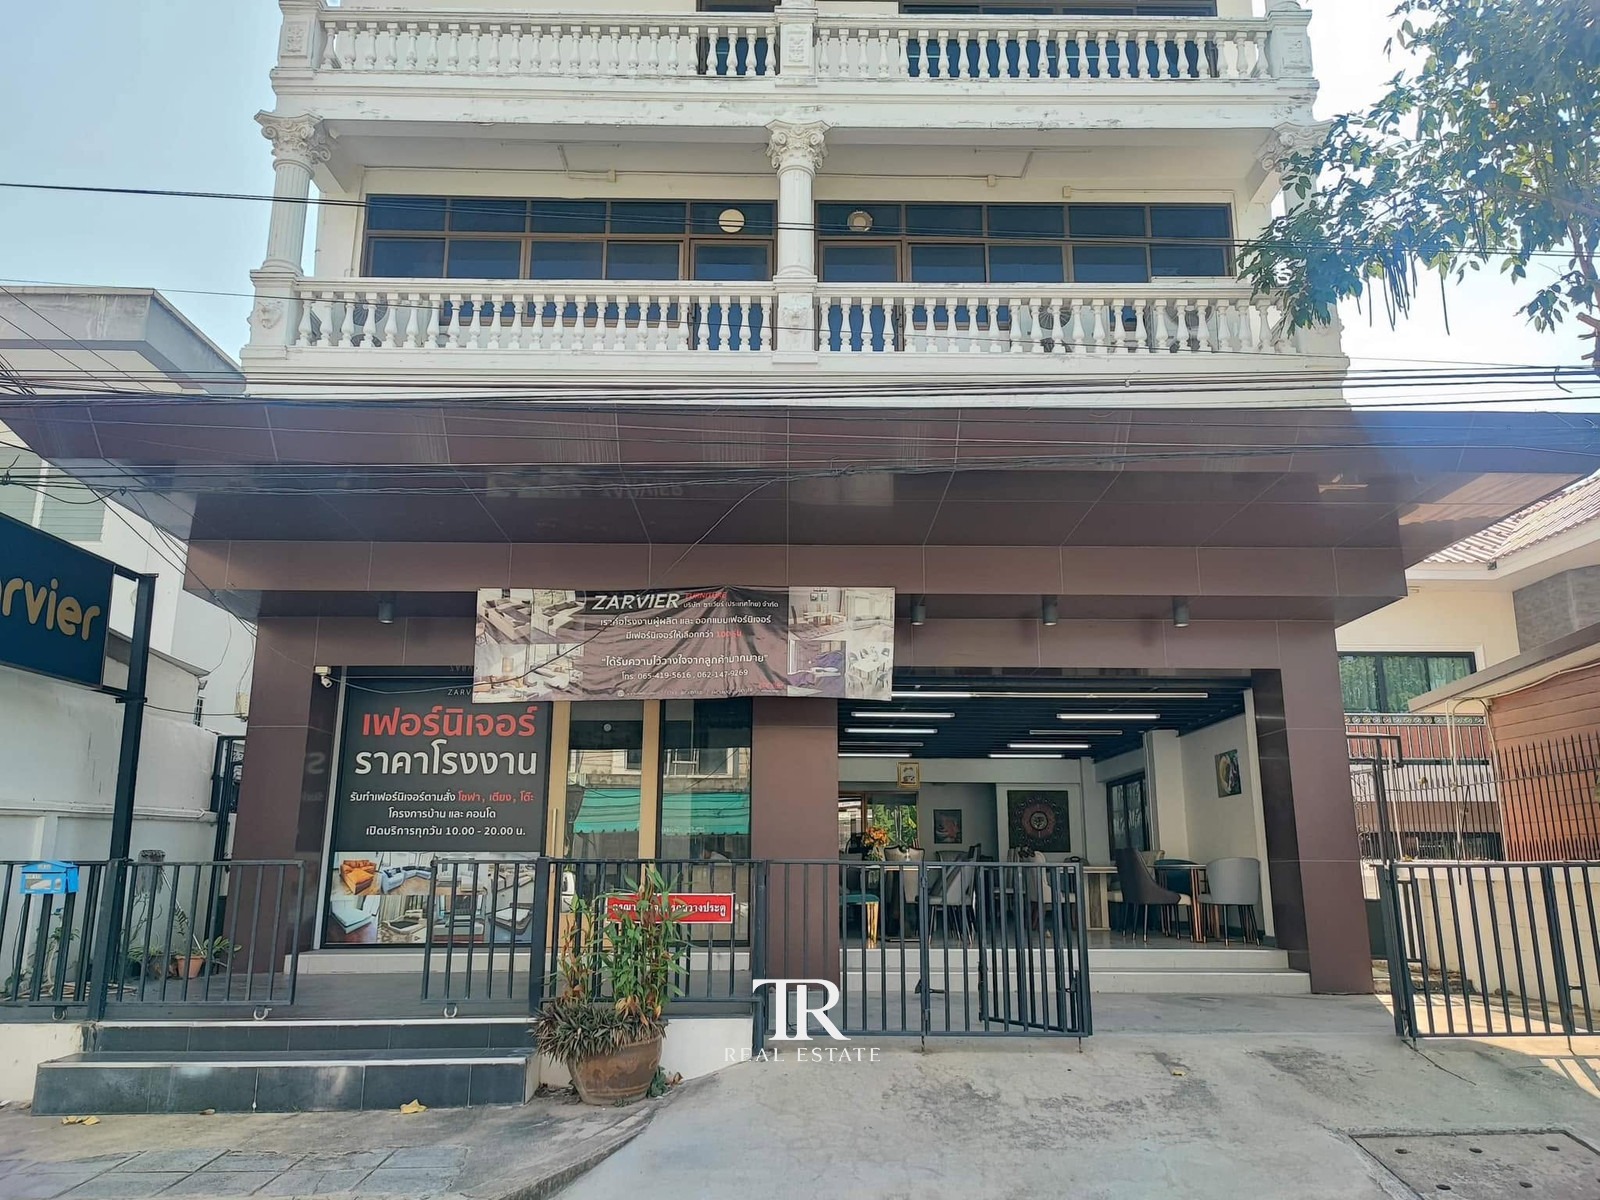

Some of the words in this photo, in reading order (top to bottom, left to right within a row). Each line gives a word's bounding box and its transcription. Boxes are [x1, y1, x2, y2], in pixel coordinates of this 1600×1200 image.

[591, 592, 681, 611] ZARVIER
[0, 577, 101, 641] rvier
[679, 616, 694, 626] และ
[697, 669, 749, 679] 062-147-9269
[447, 688, 472, 696] ZARV
[362, 705, 539, 737] เฟอร์นิเจอร์
[355, 739, 537, 775] ราคาโรงงาน
[350, 789, 456, 802] รับทำเฟอร์นิเจอร์ตามสั่ง
[388, 806, 446, 819] โครงการบ้าน
[449, 808, 464, 818] และ
[466, 807, 496, 819] คอนโด
[366, 824, 443, 838] เปิดบริการทุกวัน
[445, 826, 475, 836] 10.00
[484, 826, 513, 836] 20.00
[515, 827, 526, 836] น.
